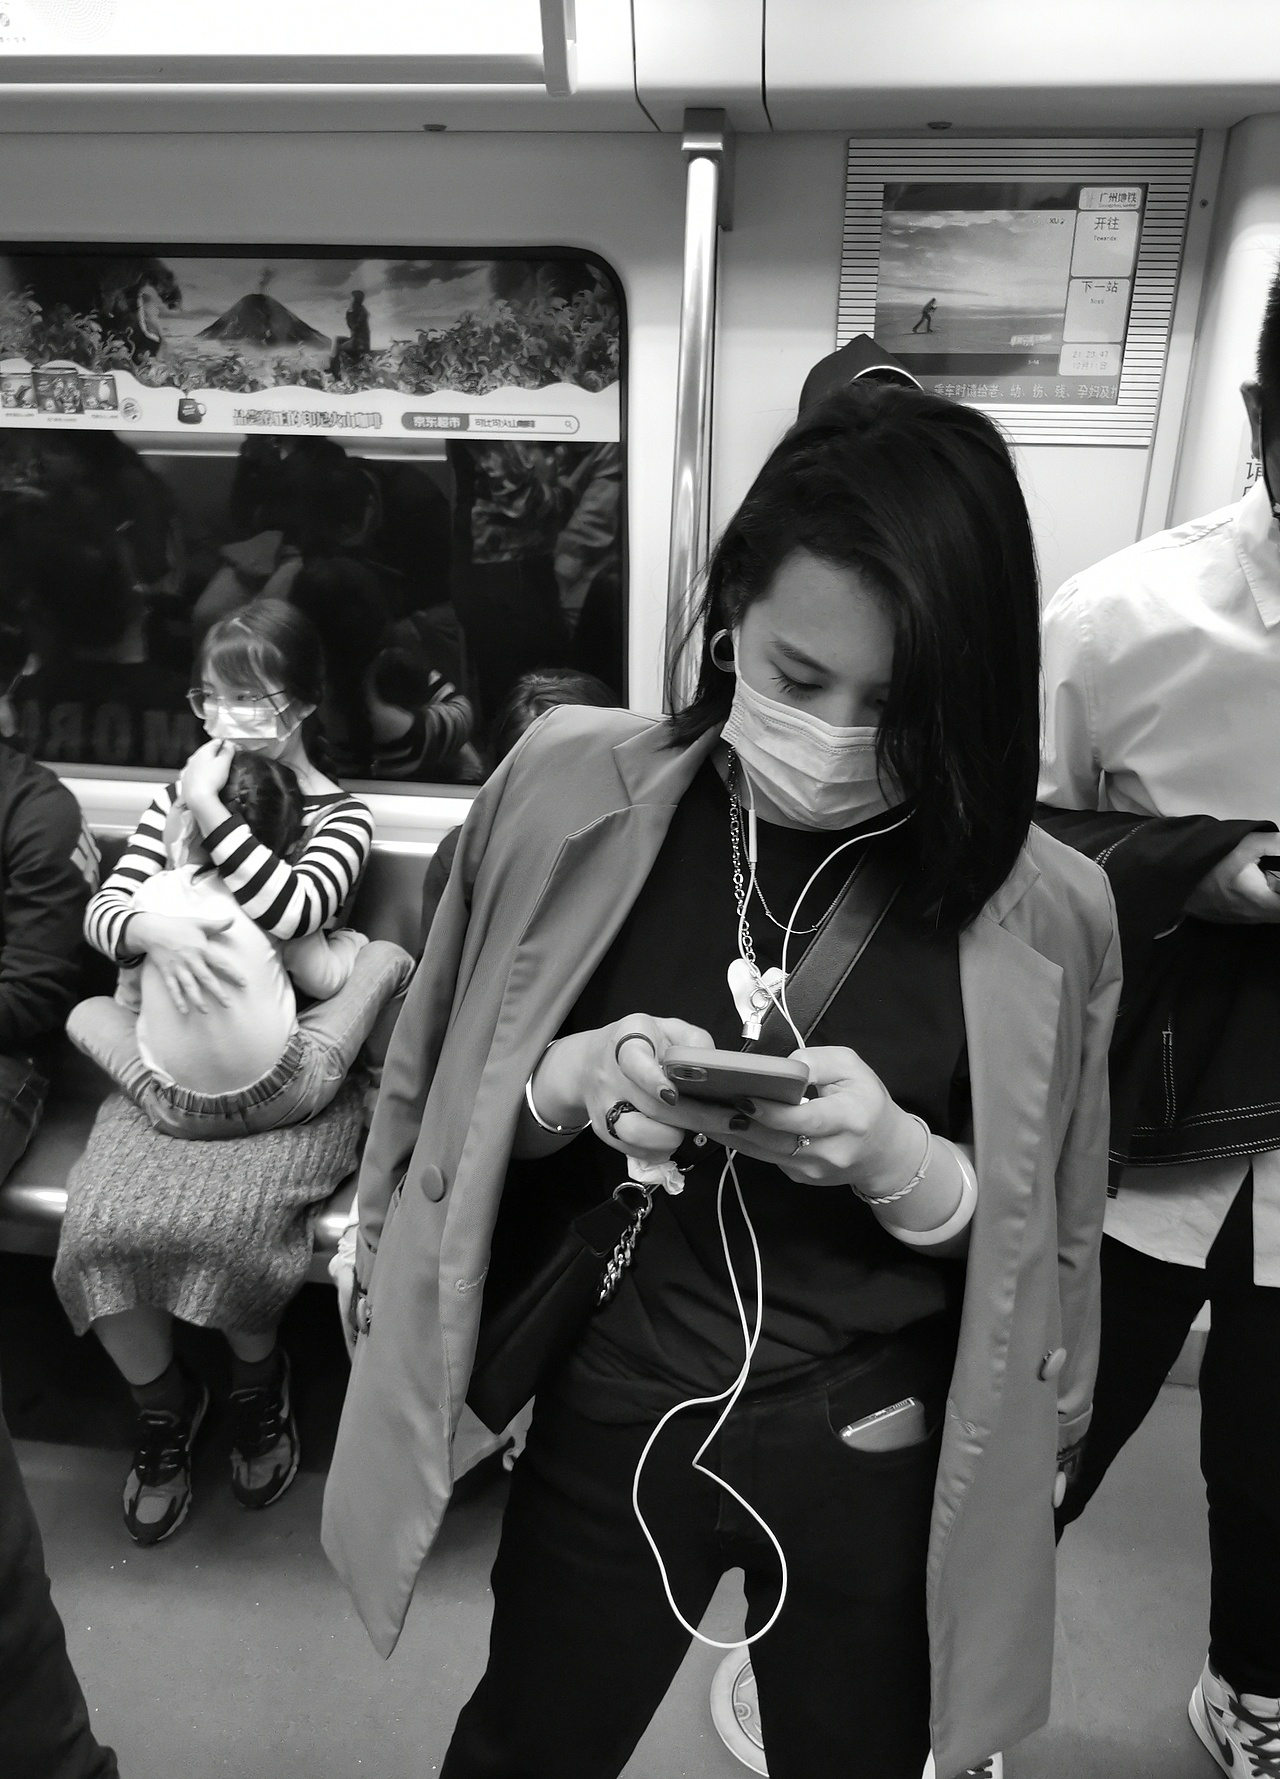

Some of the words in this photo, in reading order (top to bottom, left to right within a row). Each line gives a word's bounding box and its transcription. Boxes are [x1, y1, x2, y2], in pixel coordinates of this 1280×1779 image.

[1099, 192, 1137, 203] 广州地铁
[1093, 216, 1119, 231] 开往
[1081, 280, 1119, 293] 下一站
[413, 416, 461, 429] 京东超市
